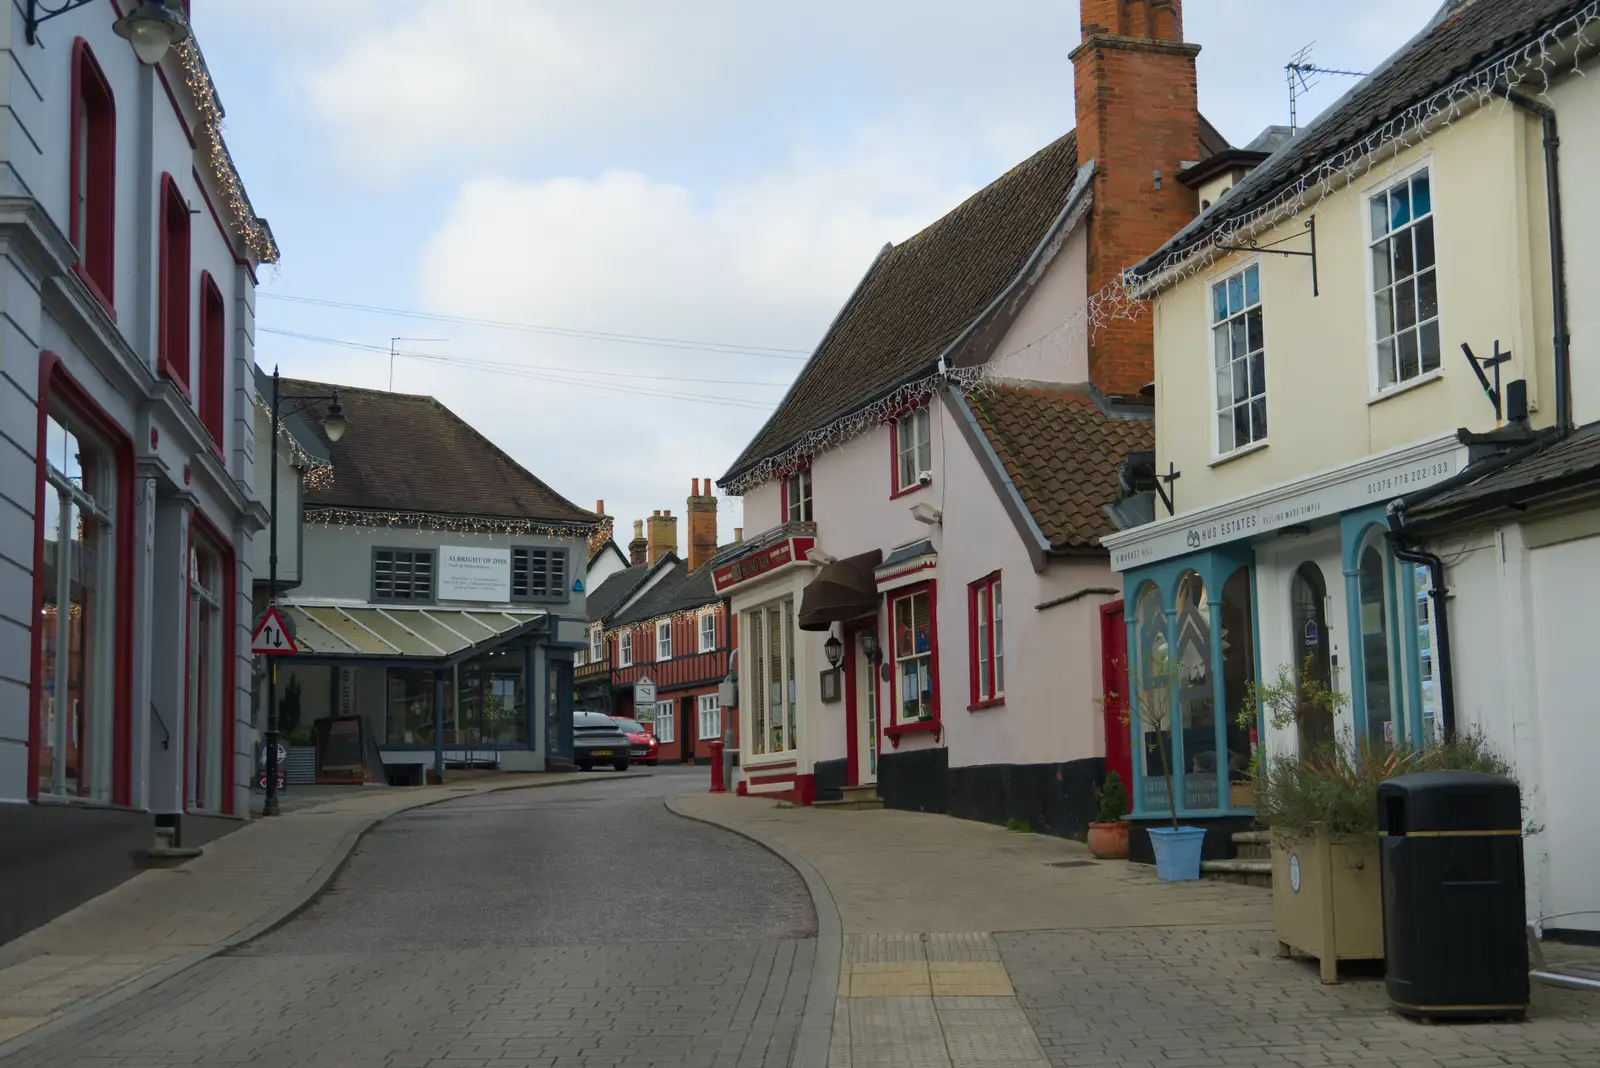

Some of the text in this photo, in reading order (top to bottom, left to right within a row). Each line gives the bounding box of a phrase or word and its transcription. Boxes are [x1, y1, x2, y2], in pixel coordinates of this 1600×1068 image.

[1367, 478, 1392, 495] 01379
[1411, 462, 1449, 482] 222/333
[1301, 502, 1321, 516] SIMPLE
[1202, 515, 1257, 541] HUS ESTATES
[1120, 549, 1140, 563] MARKET
